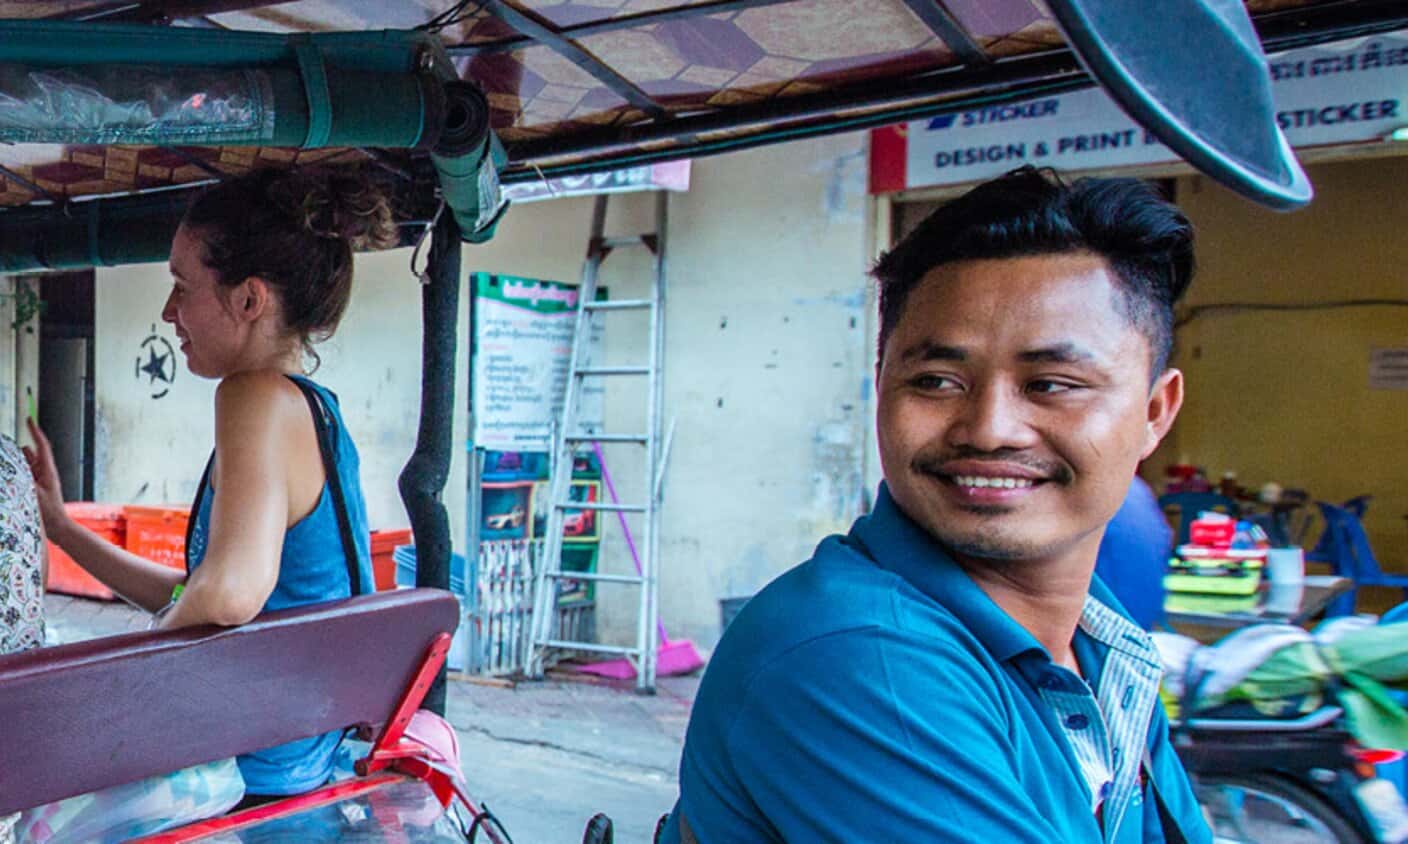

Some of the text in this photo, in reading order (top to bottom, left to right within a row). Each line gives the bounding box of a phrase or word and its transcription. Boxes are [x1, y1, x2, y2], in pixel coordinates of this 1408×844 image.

[934, 142, 1027, 169] DESIGN
[1033, 141, 1050, 157] &
[1057, 128, 1137, 154] PRINT
[1276, 99, 1400, 130] STICKER
[961, 99, 1060, 127] STICKER
